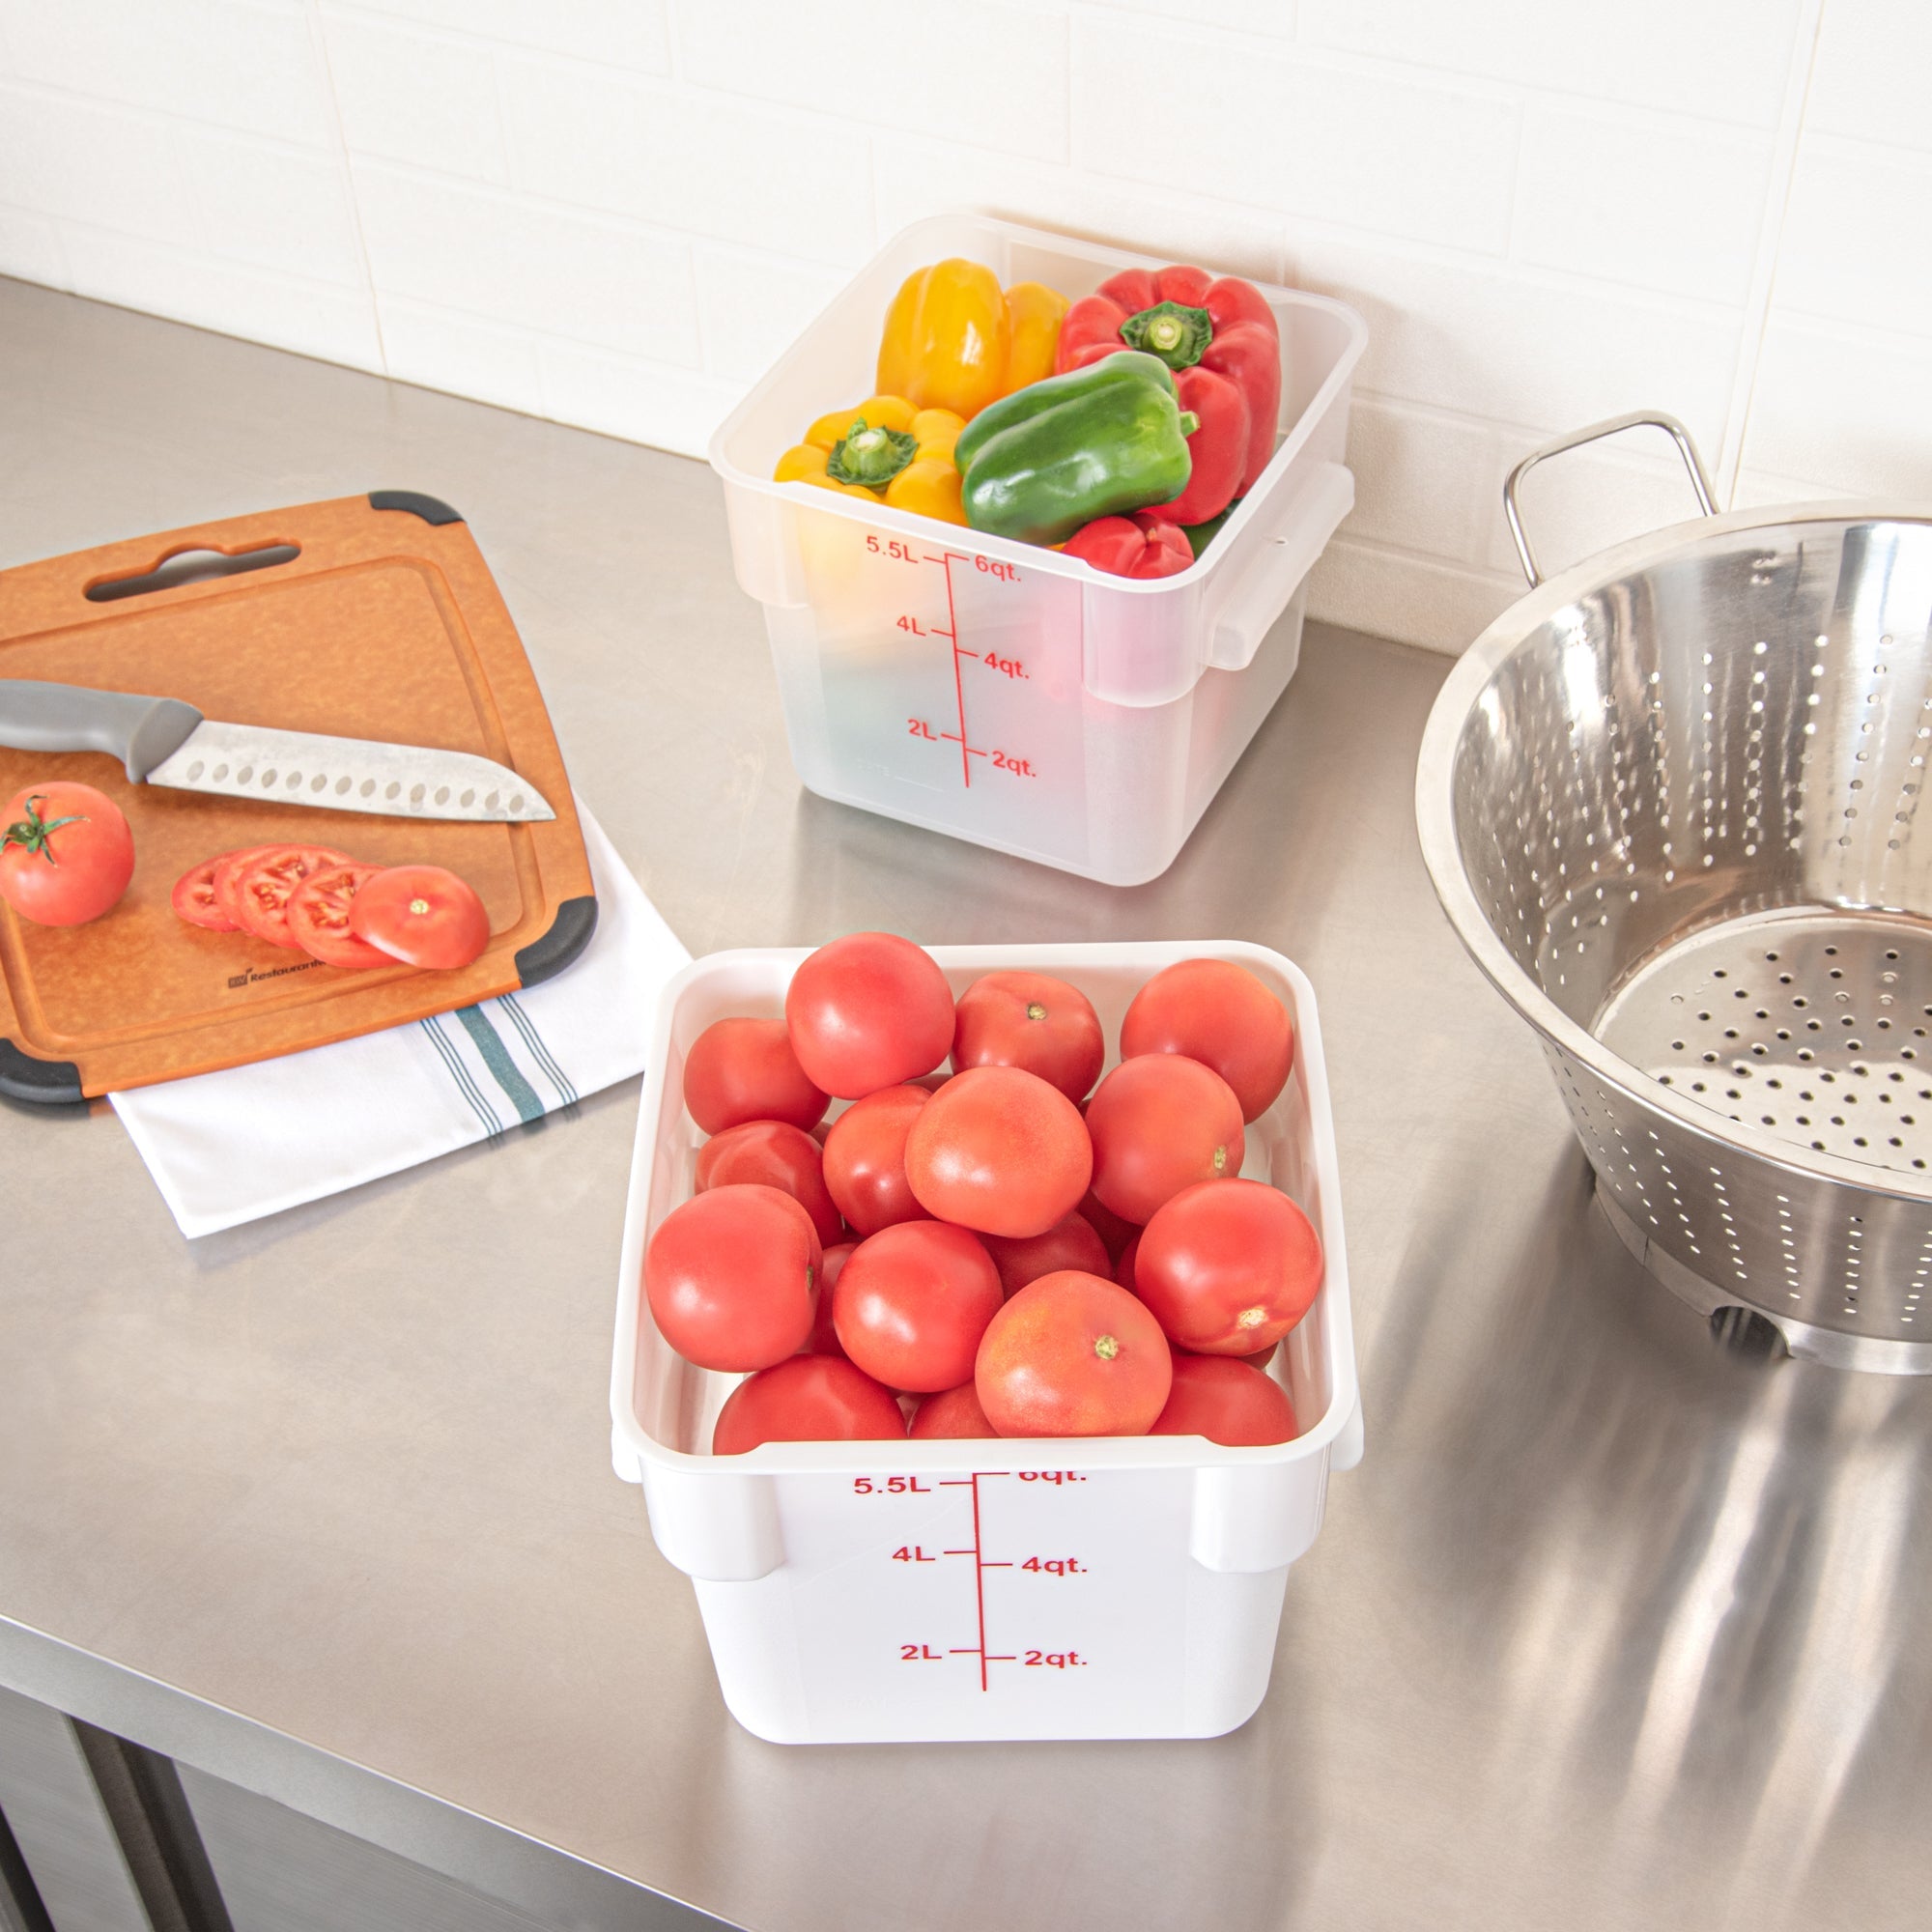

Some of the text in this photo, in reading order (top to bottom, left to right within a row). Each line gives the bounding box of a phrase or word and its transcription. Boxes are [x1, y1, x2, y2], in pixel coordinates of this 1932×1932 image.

[867, 535, 919, 564] 5.5L
[975, 554, 1022, 582] 6qt.
[896, 615, 926, 638] 4L
[984, 652, 1030, 679] 4qt.
[908, 719, 937, 741] 2L
[993, 750, 1037, 778] 2qt.
[250, 958, 327, 982] Restaurant
[854, 1476, 931, 1494] 5.5L
[892, 1546, 936, 1562] 4L
[1021, 1556, 1088, 1577] 4qt.
[900, 1644, 943, 1661] 2L
[1024, 1650, 1088, 1669] 2qt.
